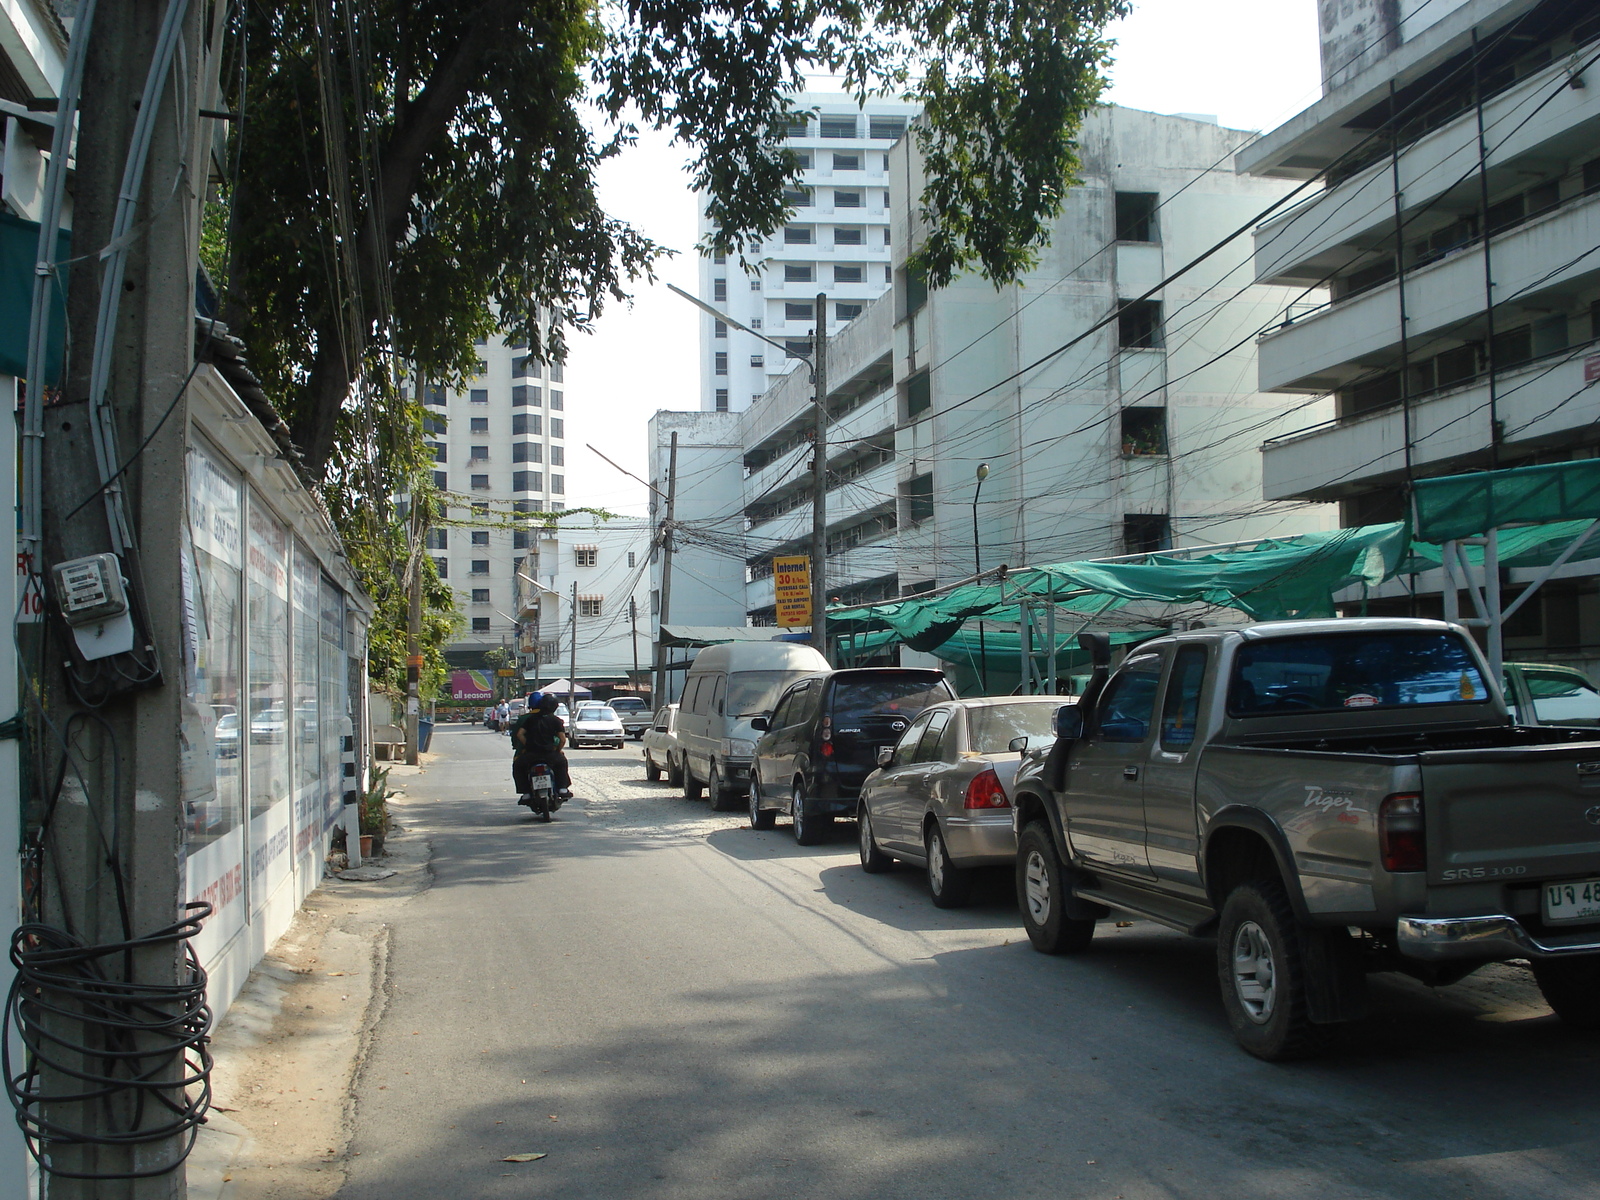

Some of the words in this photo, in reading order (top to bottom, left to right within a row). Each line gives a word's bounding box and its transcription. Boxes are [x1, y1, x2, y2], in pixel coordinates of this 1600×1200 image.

[777, 561, 805, 573] Internet
[779, 574, 791, 585] 30
[453, 690, 463, 699] all
[1304, 785, 1368, 813] Tiger
[1442, 867, 1486, 880] SR5
